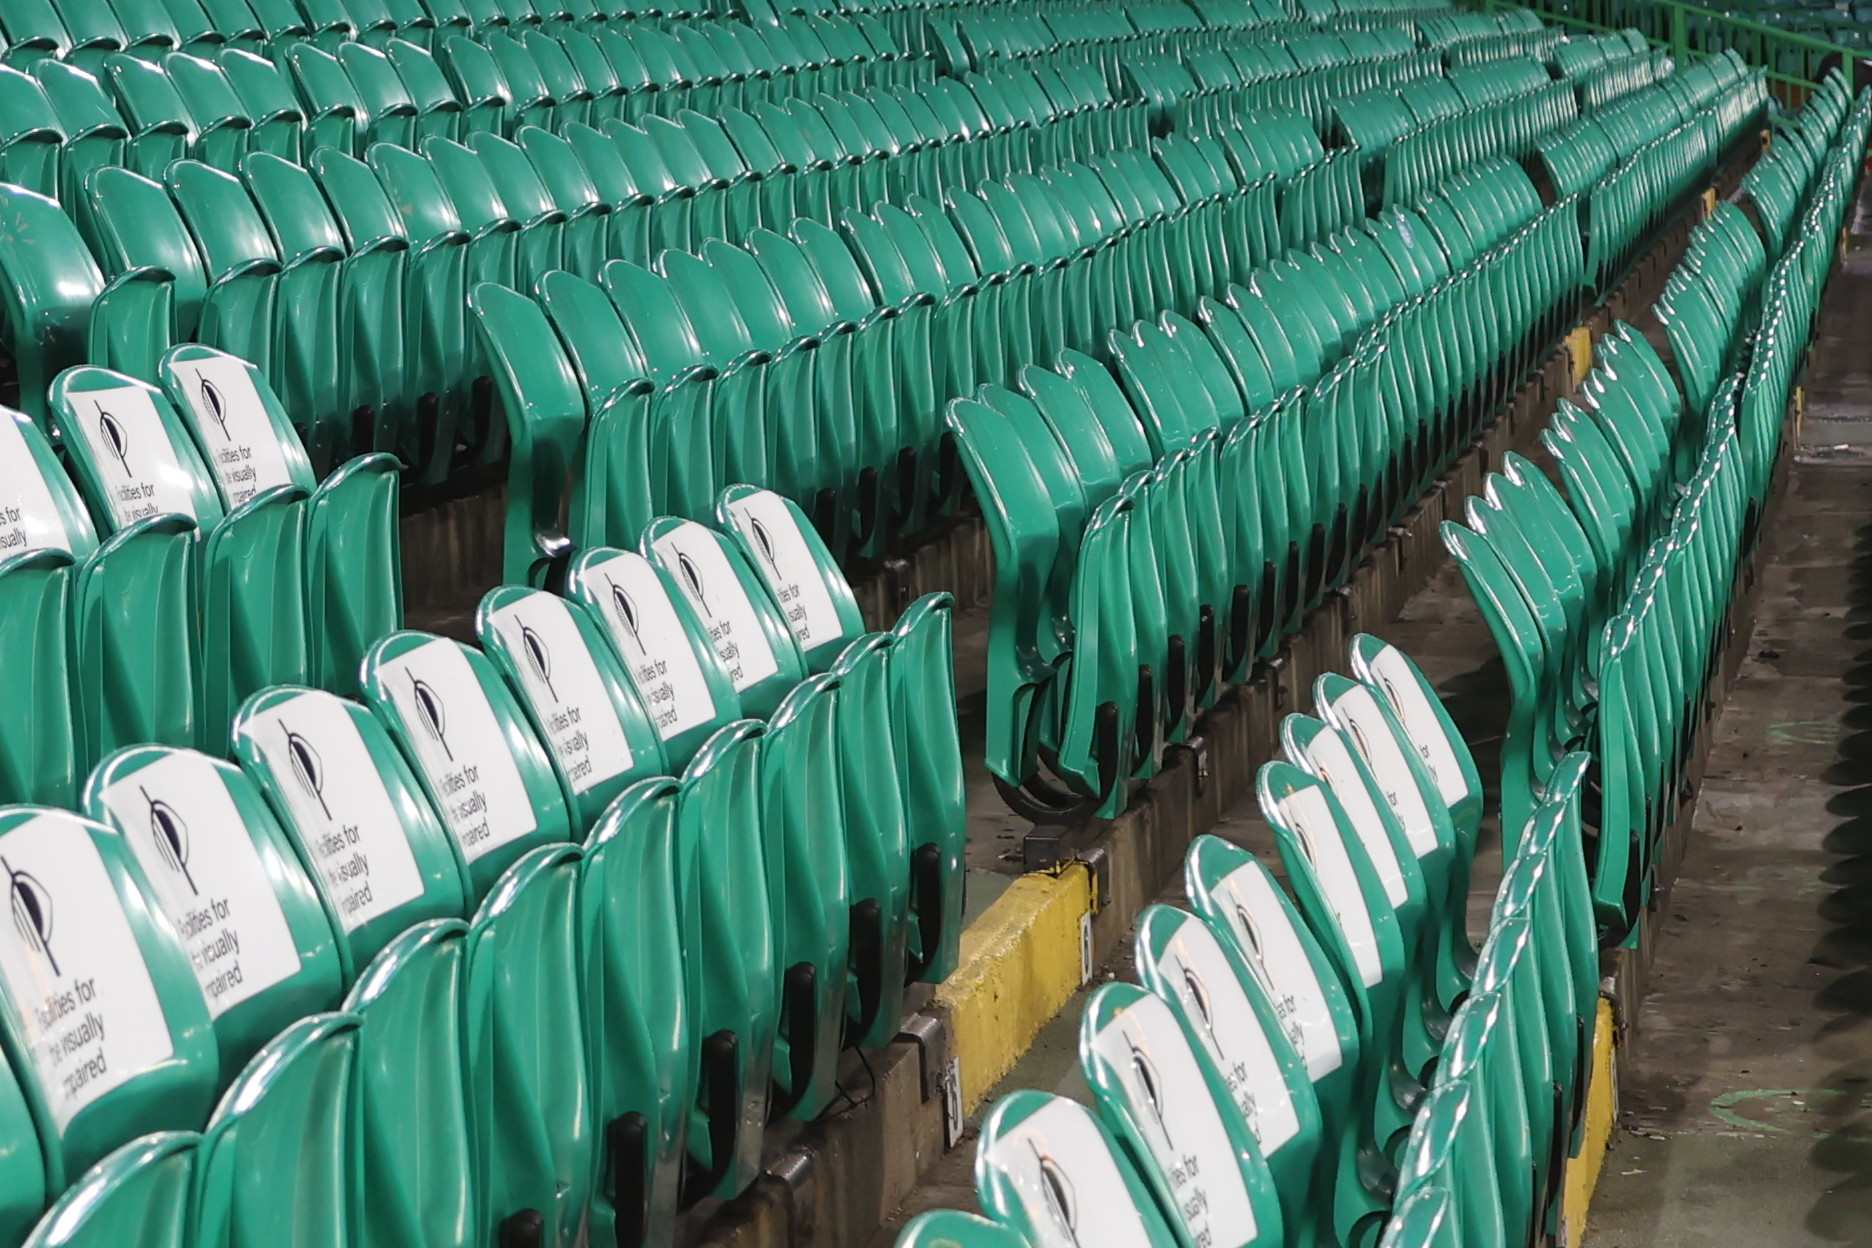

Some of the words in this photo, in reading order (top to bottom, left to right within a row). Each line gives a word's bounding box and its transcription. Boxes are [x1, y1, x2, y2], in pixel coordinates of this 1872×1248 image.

[141, 482, 155, 497] for
[6, 507, 21, 522] for
[654, 659, 668, 676] for
[567, 706, 581, 725] for
[463, 765, 479, 784] for
[343, 824, 360, 845] for
[211, 898, 231, 922] for
[75, 978, 97, 1005] for
[62, 1012, 105, 1056] visually
